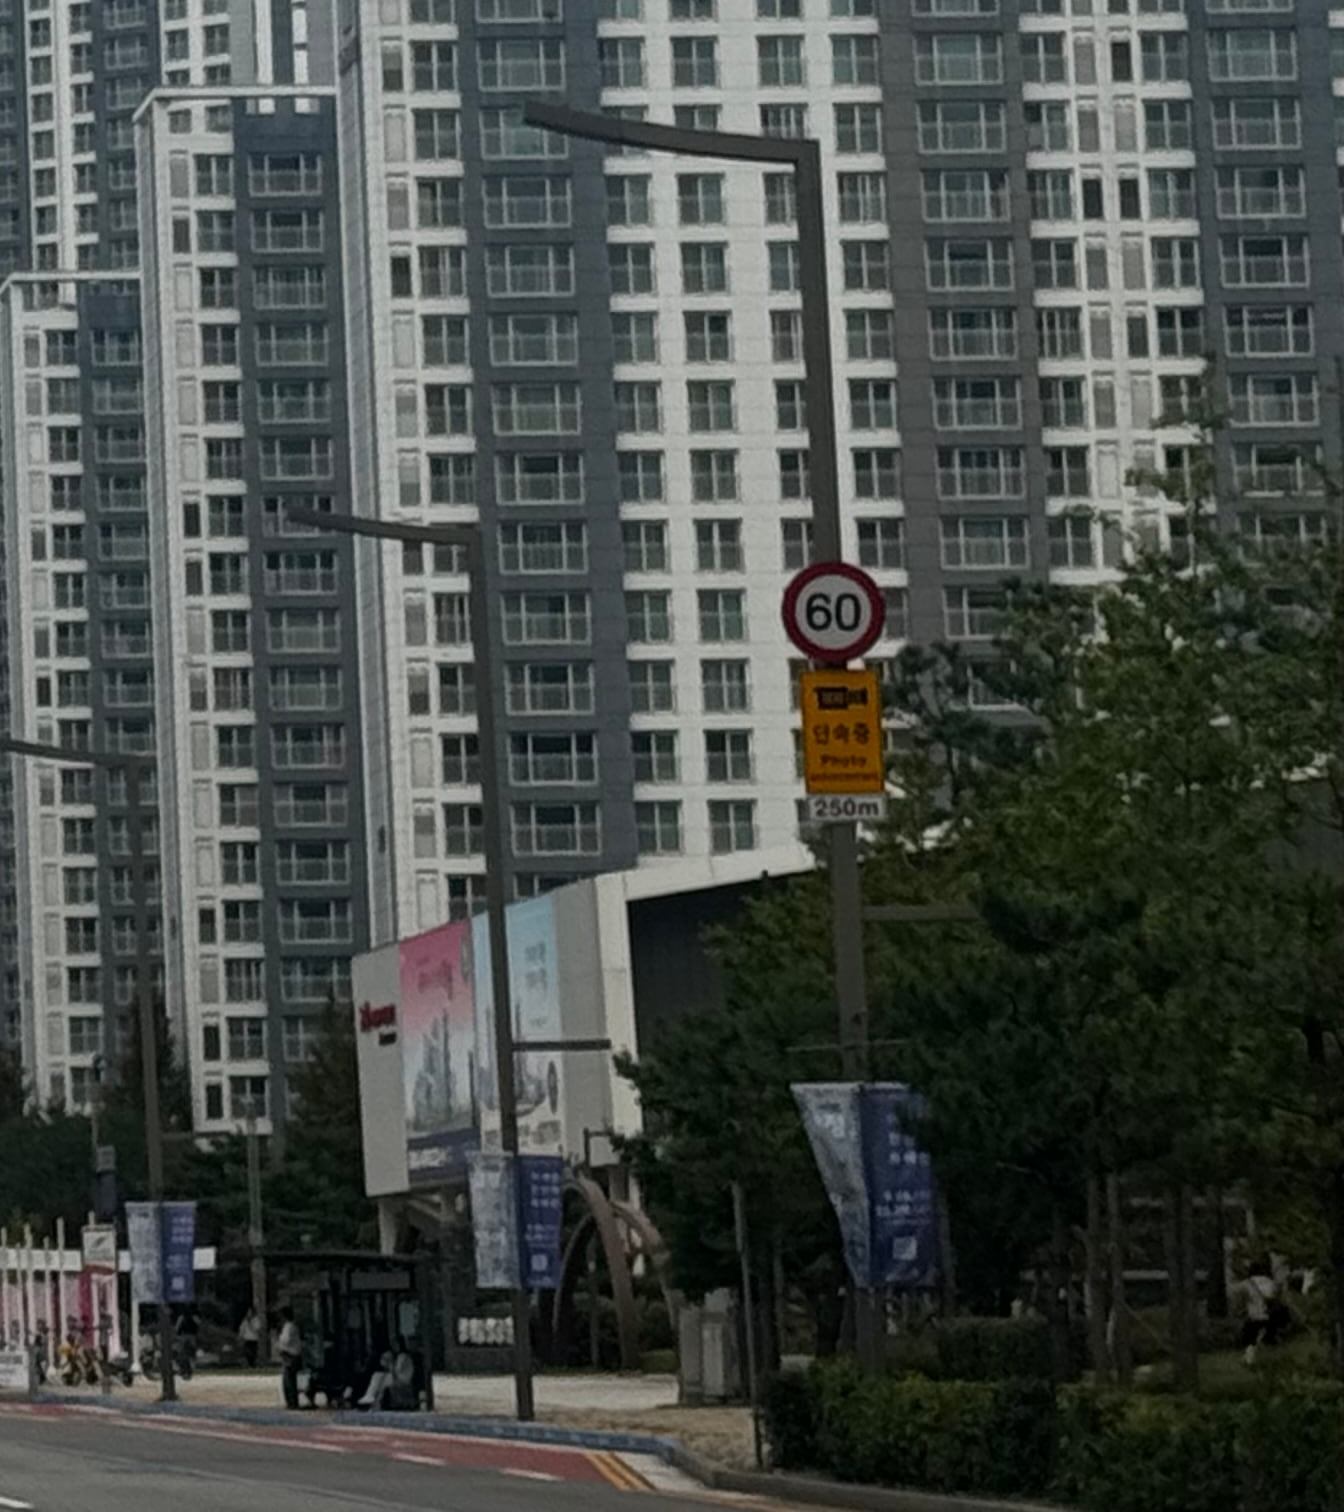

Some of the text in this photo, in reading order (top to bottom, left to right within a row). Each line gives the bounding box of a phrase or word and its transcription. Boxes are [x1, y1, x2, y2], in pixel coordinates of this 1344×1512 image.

[805, 592, 862, 632] 60
[813, 722, 871, 746] 단속중
[814, 798, 880, 818] 250m
